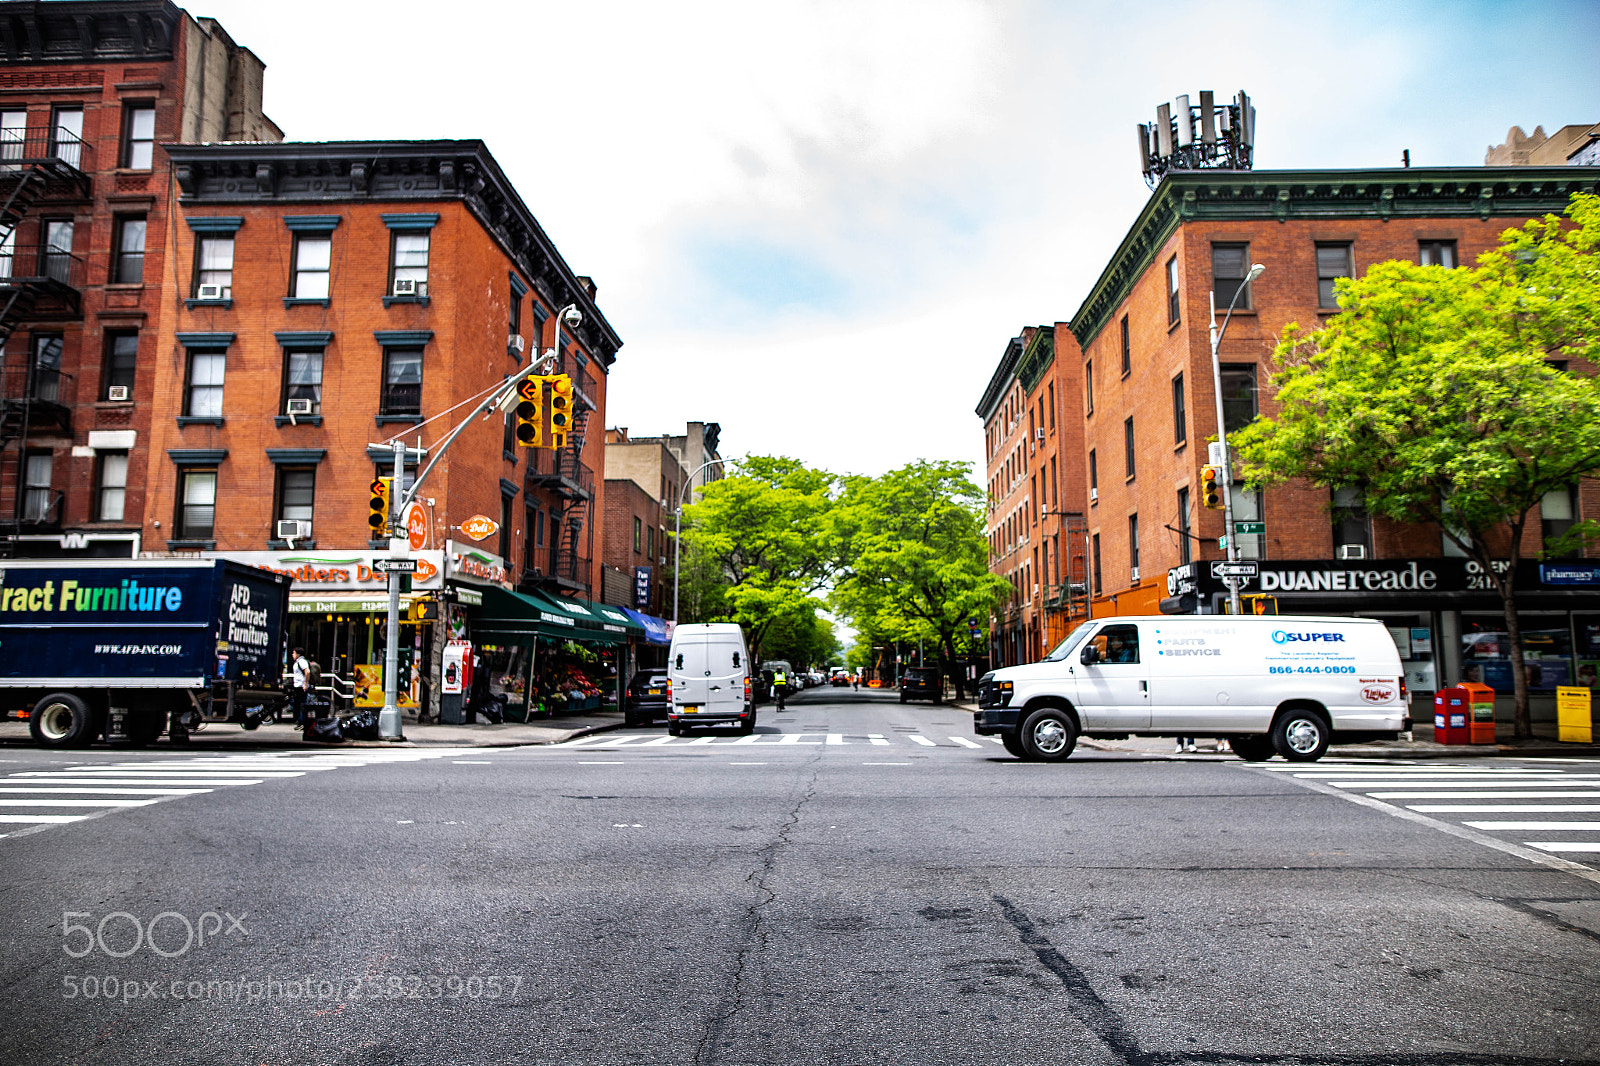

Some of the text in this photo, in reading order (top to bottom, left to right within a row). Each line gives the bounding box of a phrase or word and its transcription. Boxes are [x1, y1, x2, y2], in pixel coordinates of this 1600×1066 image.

[410, 520, 424, 535] Deli
[469, 523, 488, 533] Deli
[1243, 523, 1249, 533] 9
[379, 562, 412, 570] ONE WAY
[463, 557, 493, 580] Brothers
[1465, 561, 1510, 574] OEN
[1546, 568, 1593, 581] pharmacy
[59, 579, 182, 612] Furniture
[231, 583, 250, 605] AFD
[229, 603, 268, 627] Contract
[228, 622, 269, 647] Furniture
[1286, 632, 1346, 643] SUPER
[1164, 638, 1206, 646] PARTS
[1165, 649, 1222, 657] SERVICE
[1269, 665, 1356, 674] 866-444-0809
